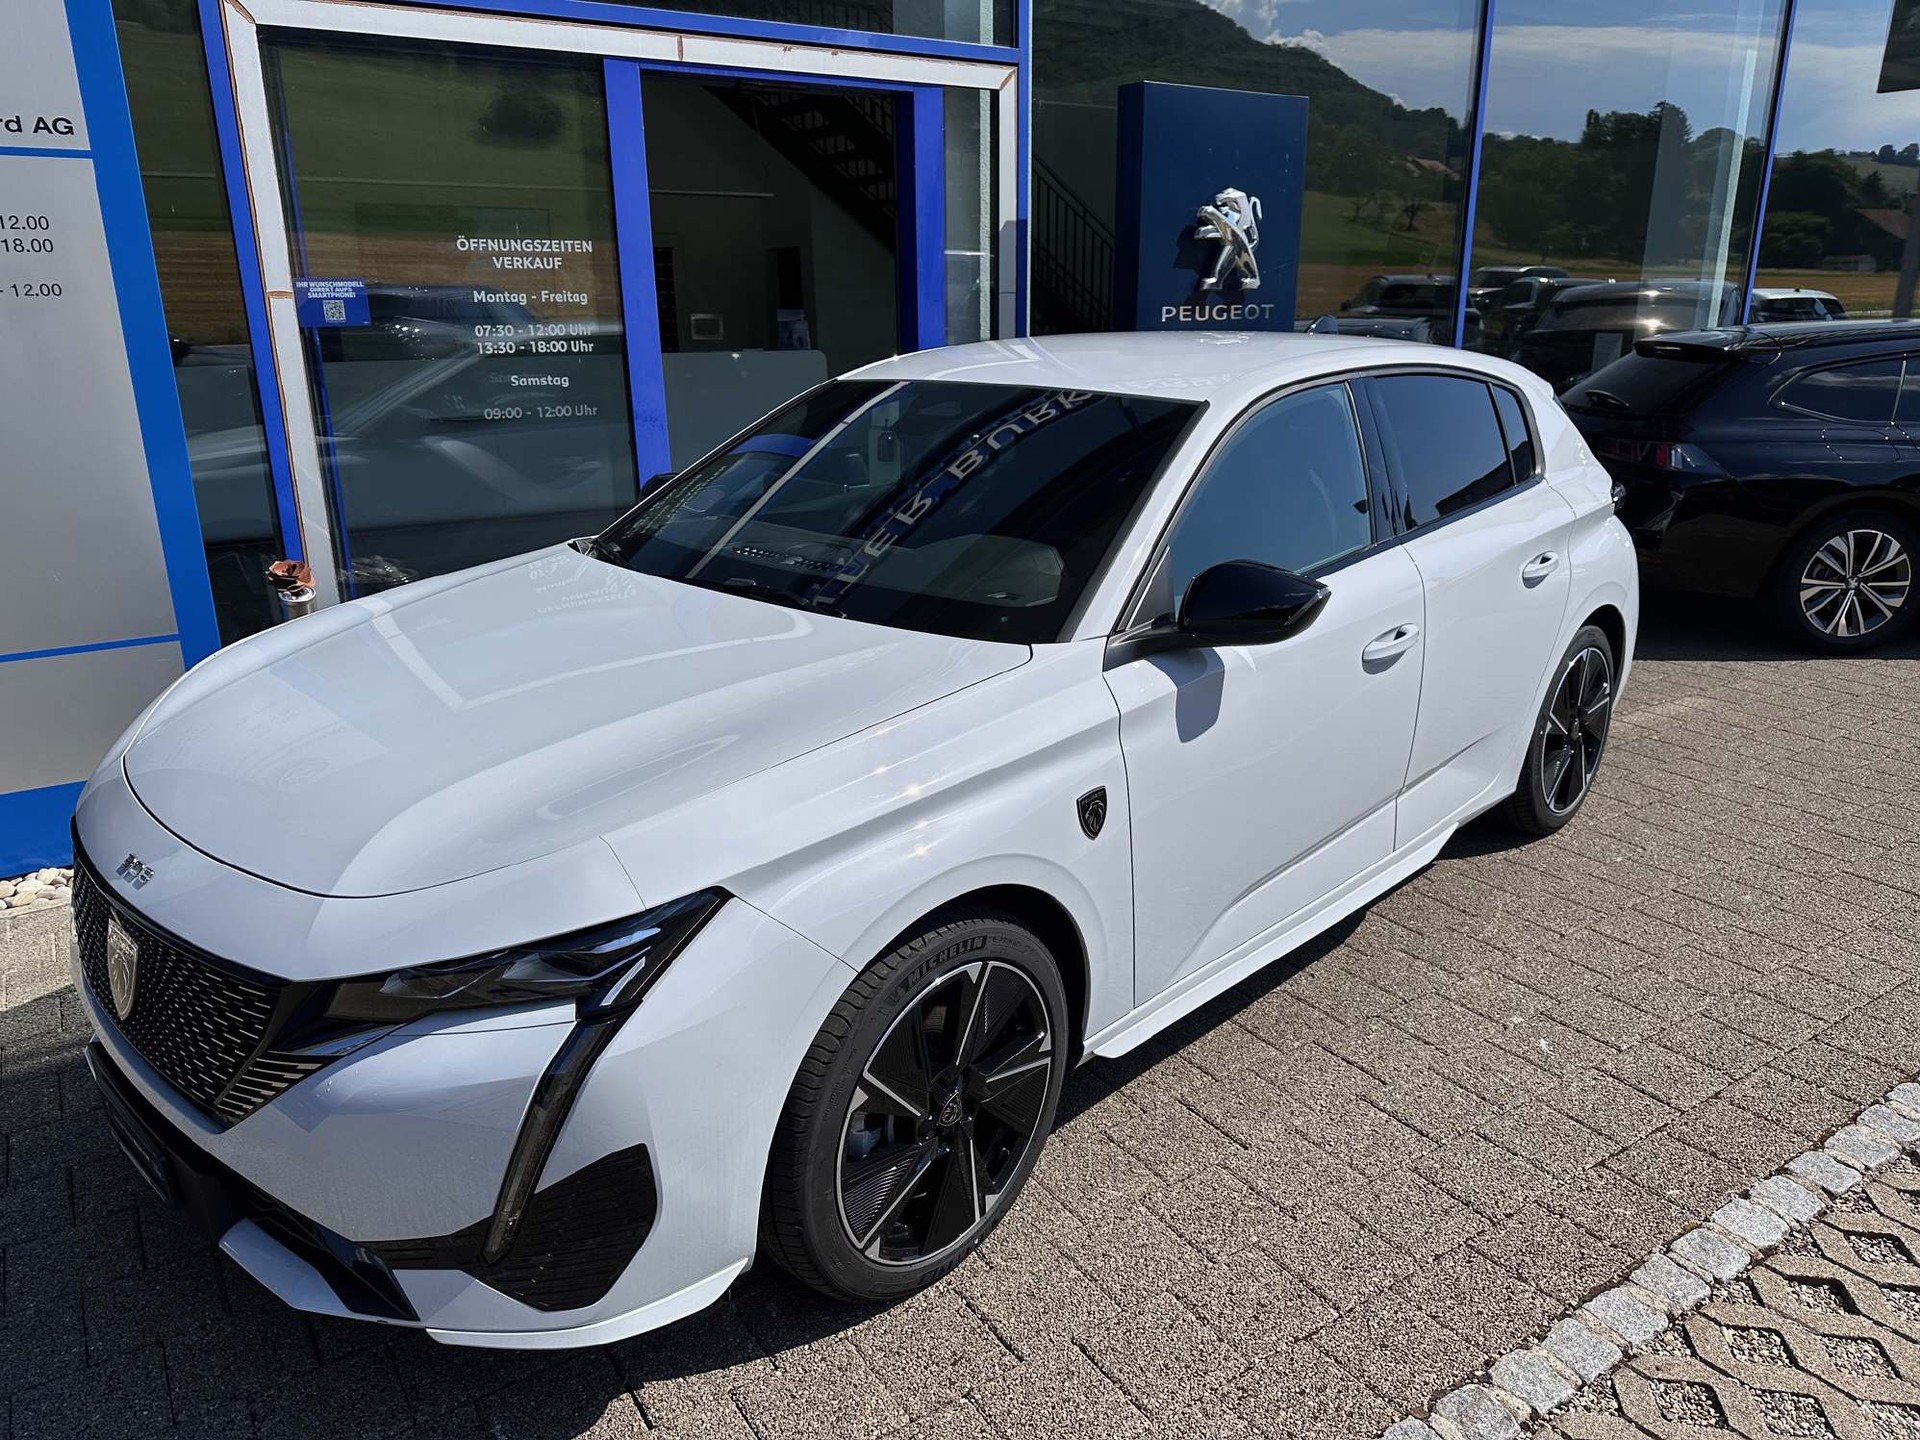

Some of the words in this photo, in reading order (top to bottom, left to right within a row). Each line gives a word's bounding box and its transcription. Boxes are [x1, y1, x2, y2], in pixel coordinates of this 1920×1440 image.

[33, 116, 75, 135] AG
[0, 215, 50, 230] 12.00
[1, 238, 54, 253] 18.00
[456, 235, 593, 253] ÖFFNUNGSZEITEN
[492, 256, 563, 269] VERKAUF
[10, 283, 62, 297] 12.00
[473, 290, 528, 305] Montag
[541, 290, 589, 305] Freitag
[1161, 303, 1275, 322] PEUGEOT
[474, 325, 514, 337] 07:30
[528, 324, 566, 336] 12:00
[569, 323, 591, 336] Uhr
[477, 341, 516, 354] 13:30
[529, 340, 568, 353] 18:00
[571, 339, 594, 352] Uhr
[510, 375, 570, 387] Samstag
[484, 407, 523, 420] 09:00
[537, 406, 572, 418] 12:00
[575, 404, 598, 416] Uhr
[907, 936, 986, 986] MICHELIN
